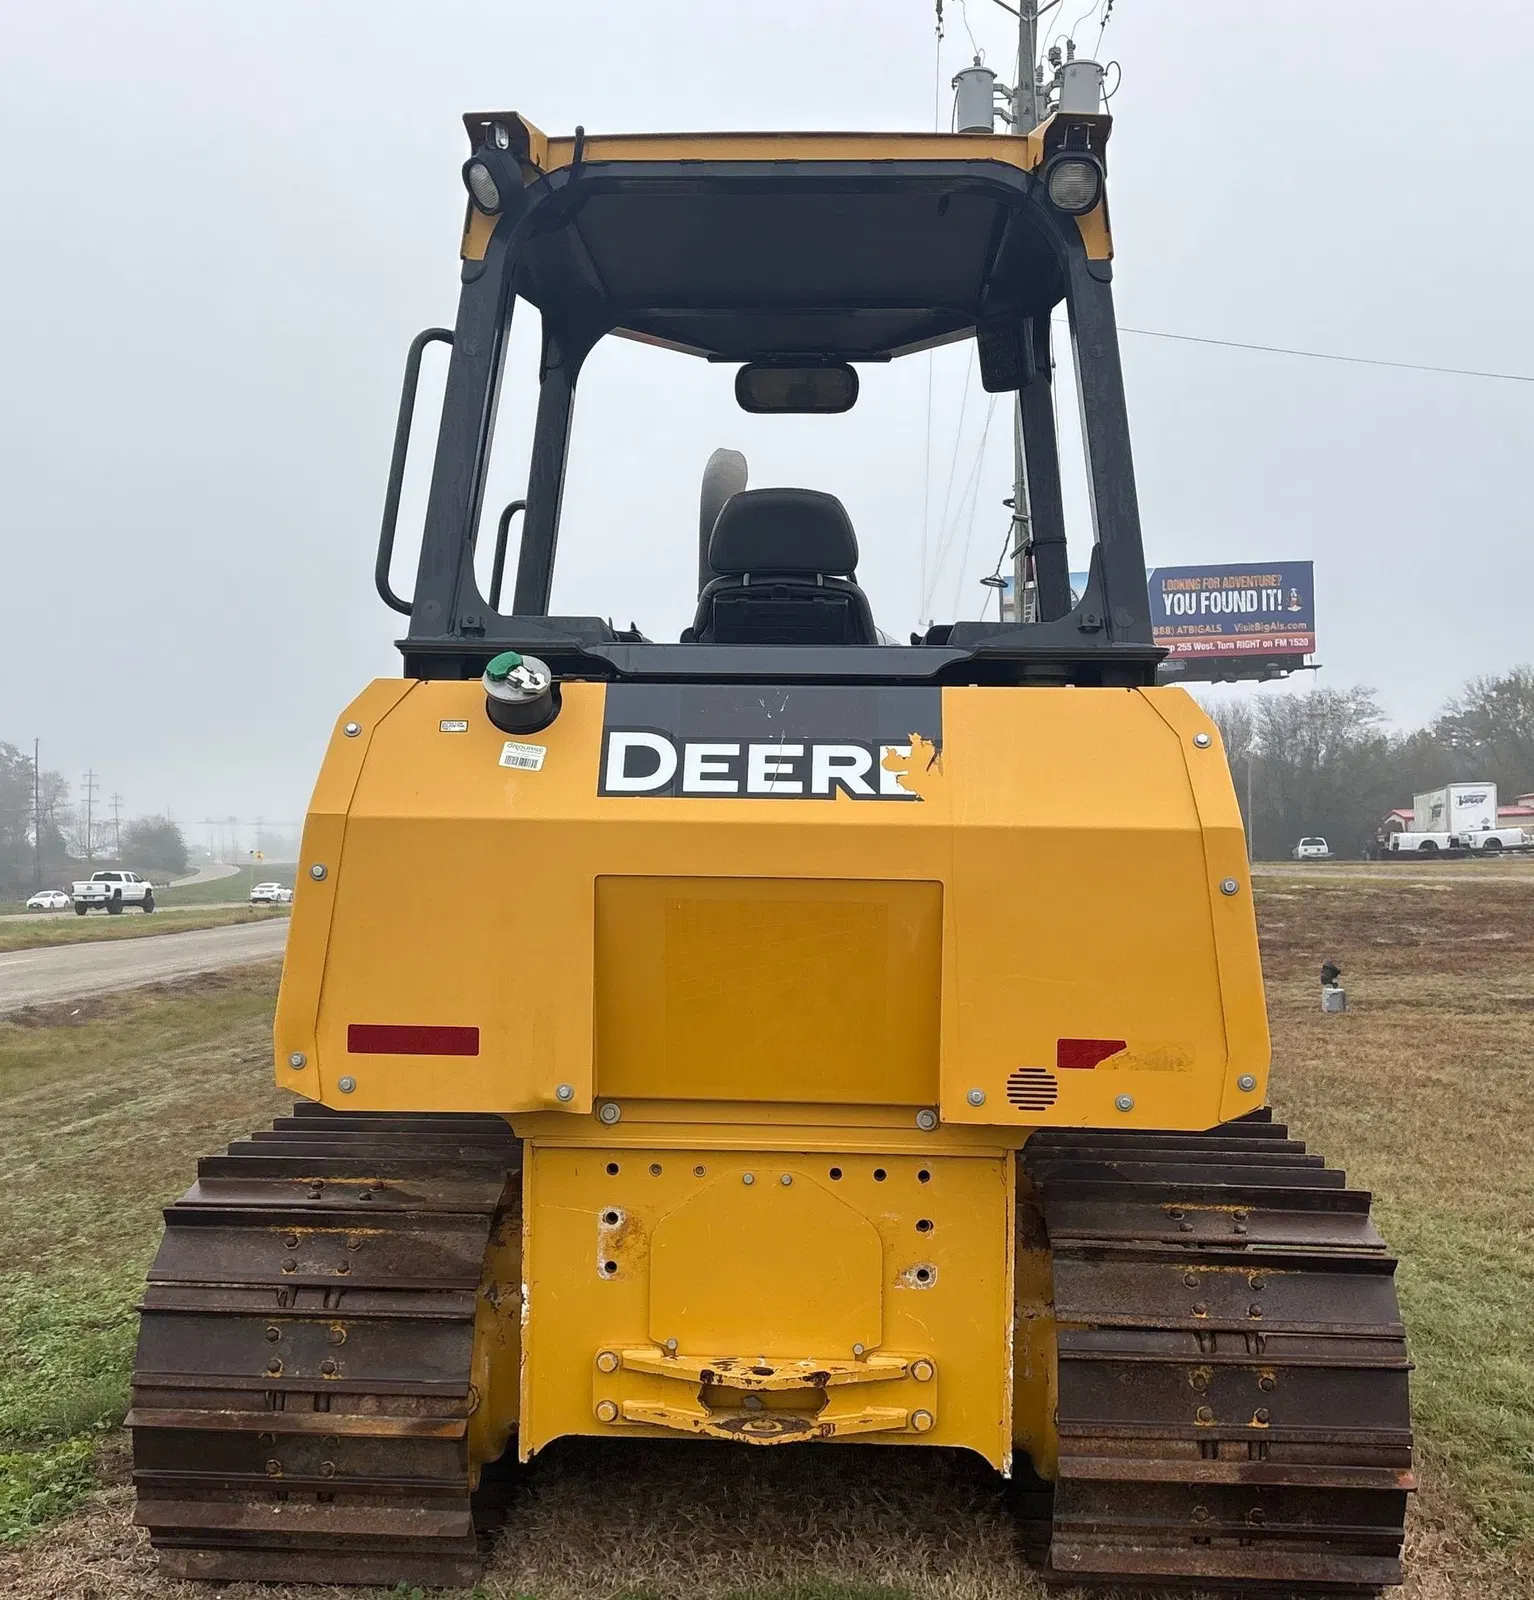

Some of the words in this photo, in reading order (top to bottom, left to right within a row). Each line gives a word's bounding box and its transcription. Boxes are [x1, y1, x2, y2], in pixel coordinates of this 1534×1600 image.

[1162, 578, 1201, 591] LOOKING
[1203, 577, 1220, 590] FOR
[1222, 574, 1282, 588] ADVENTURE?
[1162, 592, 1197, 616] YOU
[1201, 590, 1258, 614] FOUND
[1261, 589, 1282, 612] IT!
[1153, 625, 1174, 636] 888)
[1177, 623, 1222, 635] ATBIGALS
[1233, 620, 1308, 633] VisitBigAls.com
[1177, 643, 1192, 652] 255
[1217, 641, 1235, 650] Turn
[1236, 639, 1260, 650] RIGHT
[1263, 640, 1273, 648] on
[1275, 638, 1287, 648] FM
[1289, 638, 1309, 647] 1520
